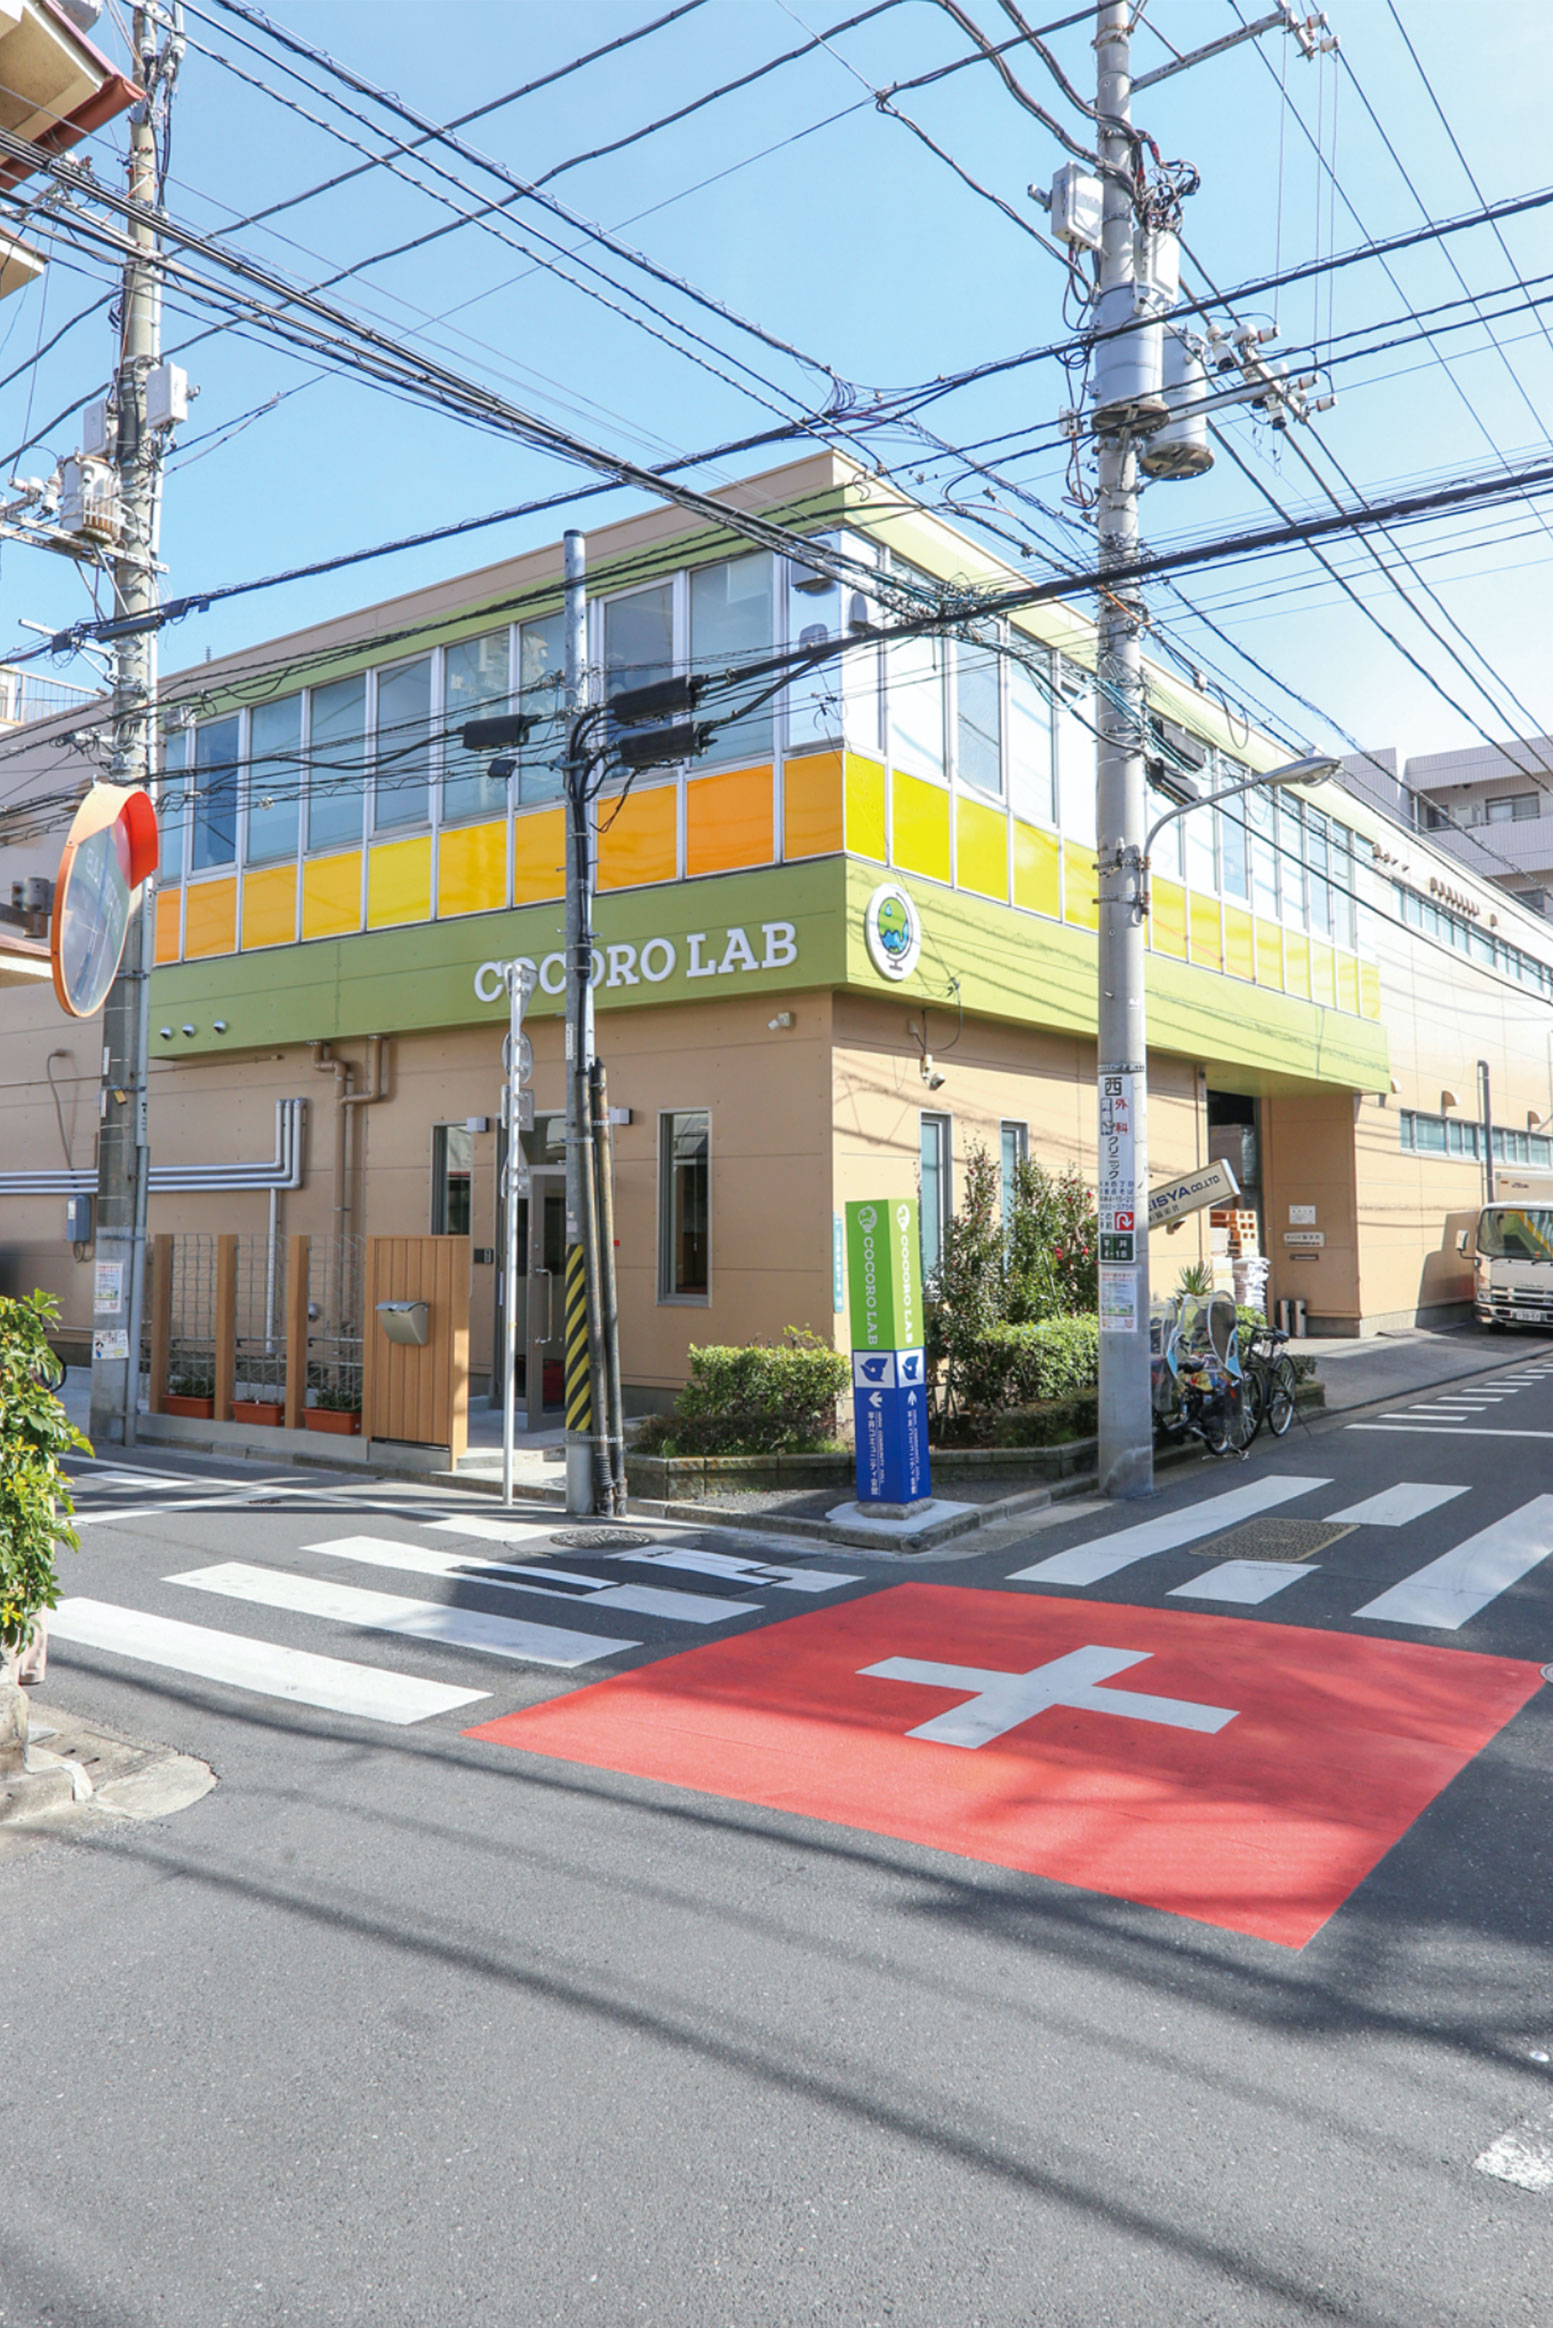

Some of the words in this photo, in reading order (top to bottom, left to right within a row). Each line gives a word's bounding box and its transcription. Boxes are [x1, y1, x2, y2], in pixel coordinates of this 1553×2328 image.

[686, 921, 798, 979] LAB
[1104, 1076, 1122, 1096] 西
[1107, 1136, 1120, 1180] クリニック
[863, 1236, 877, 1309] COCORO
[900, 1234, 913, 1307] COCORO
[866, 1311, 879, 1345] LAB
[904, 1309, 914, 1344] LAB
